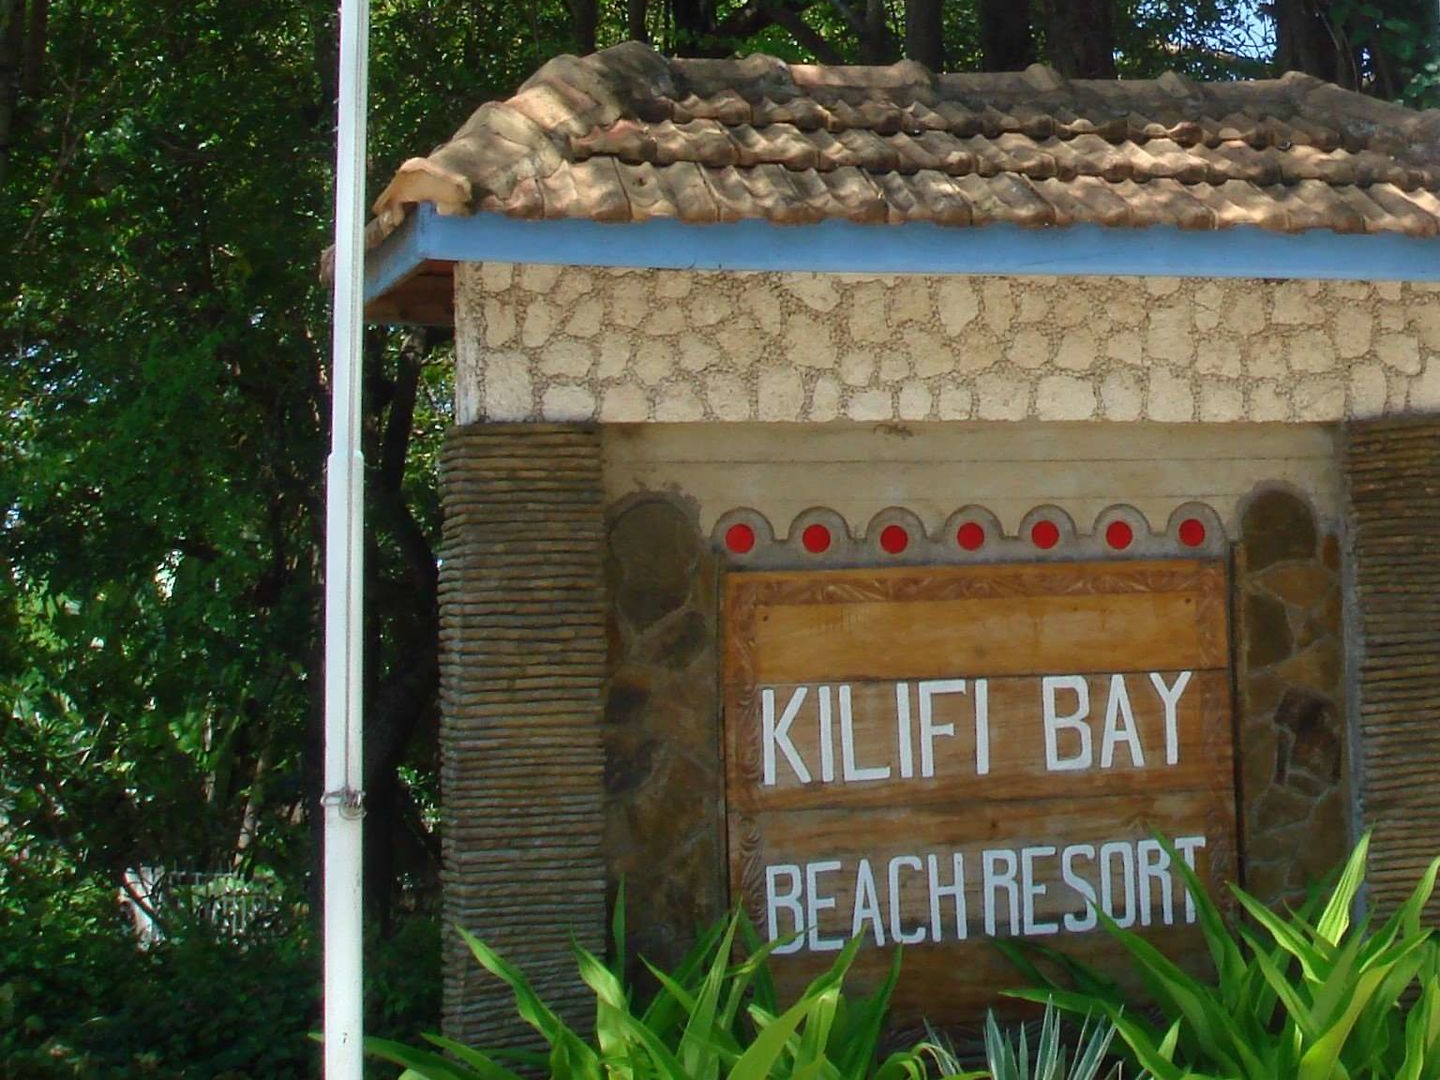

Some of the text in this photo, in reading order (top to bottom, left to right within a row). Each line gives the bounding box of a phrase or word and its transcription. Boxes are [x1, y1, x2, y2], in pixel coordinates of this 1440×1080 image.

[761, 671, 1193, 786] KILIFI BAY
[765, 836, 1207, 955] BEACH RESORT
